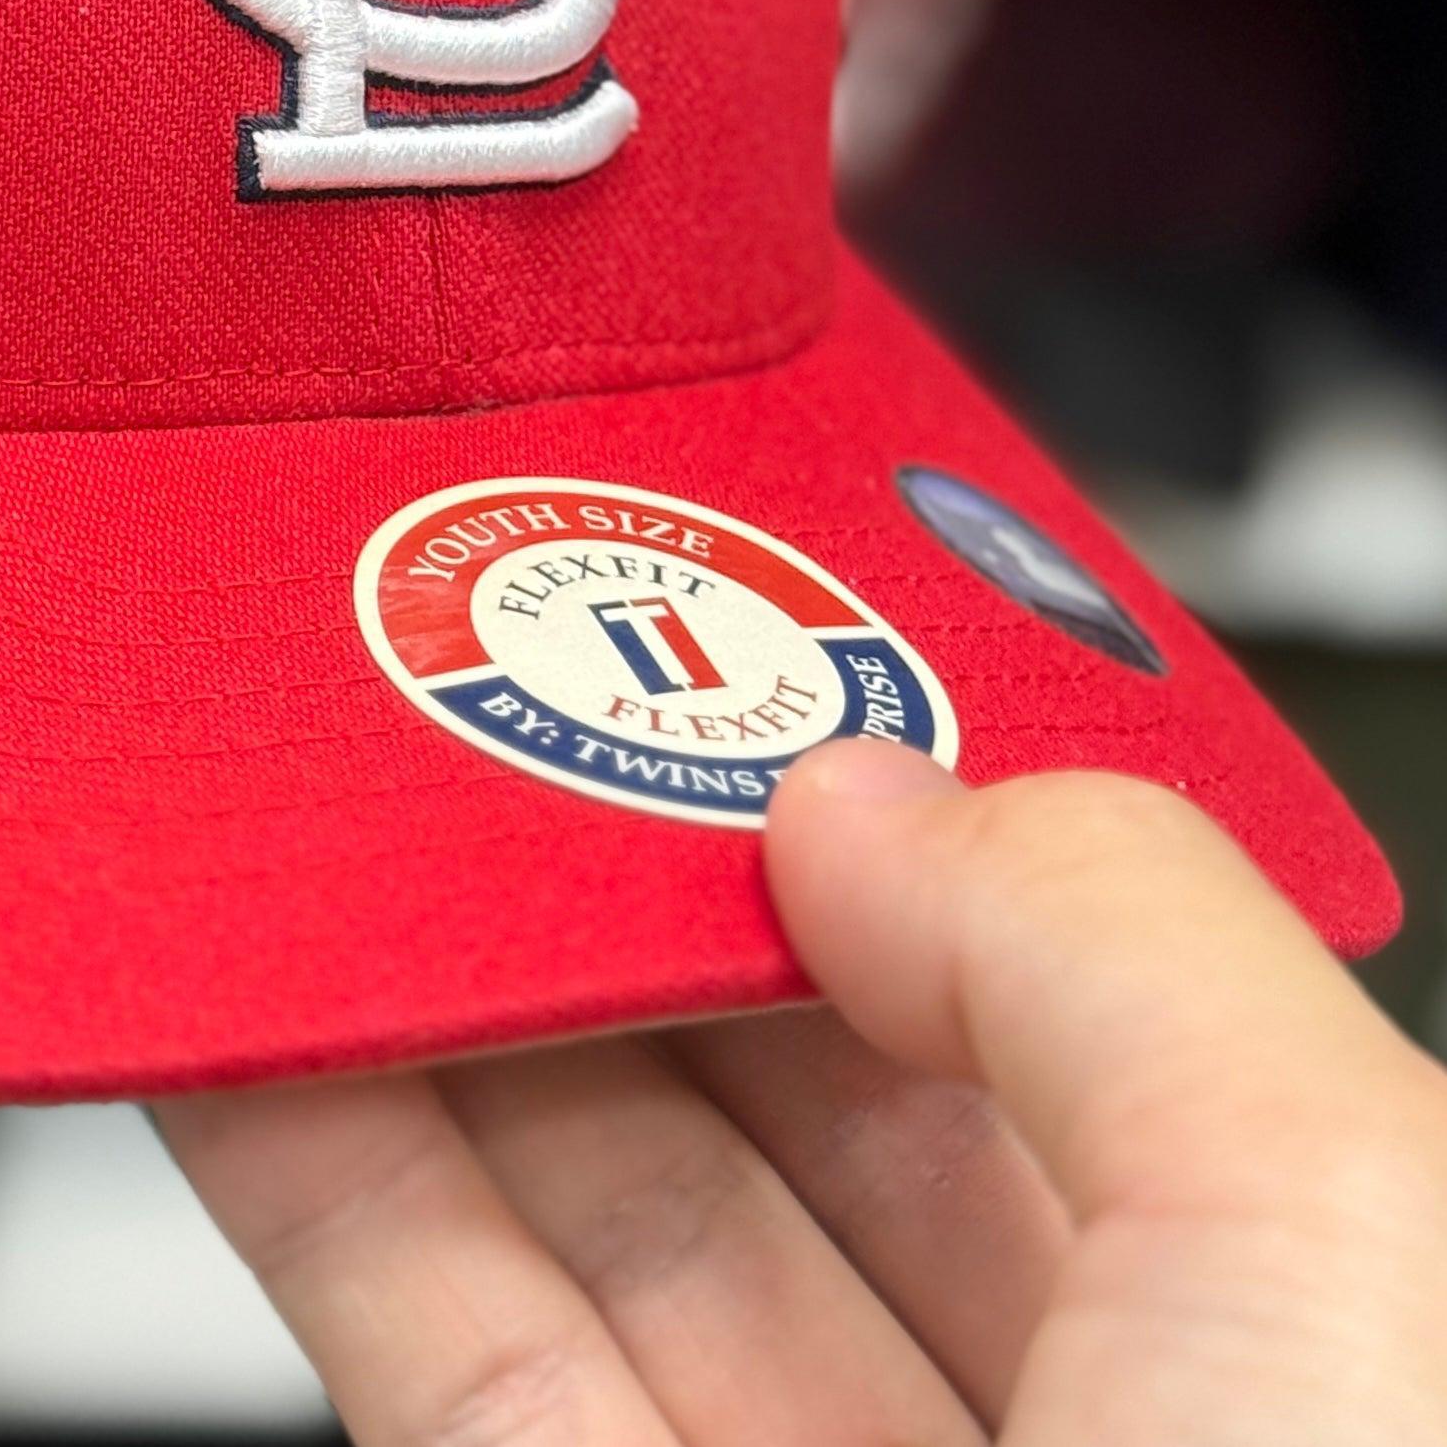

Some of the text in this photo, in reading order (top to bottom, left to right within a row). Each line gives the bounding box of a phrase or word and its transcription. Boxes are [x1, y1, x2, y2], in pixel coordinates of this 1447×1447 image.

[408, 504, 714, 583] YOUTH SIZE
[499, 553, 716, 620] FLEXFIT
[479, 692, 562, 746] BY:
[846, 653, 906, 742] PRISE
[602, 675, 818, 742] FLEXFIT
